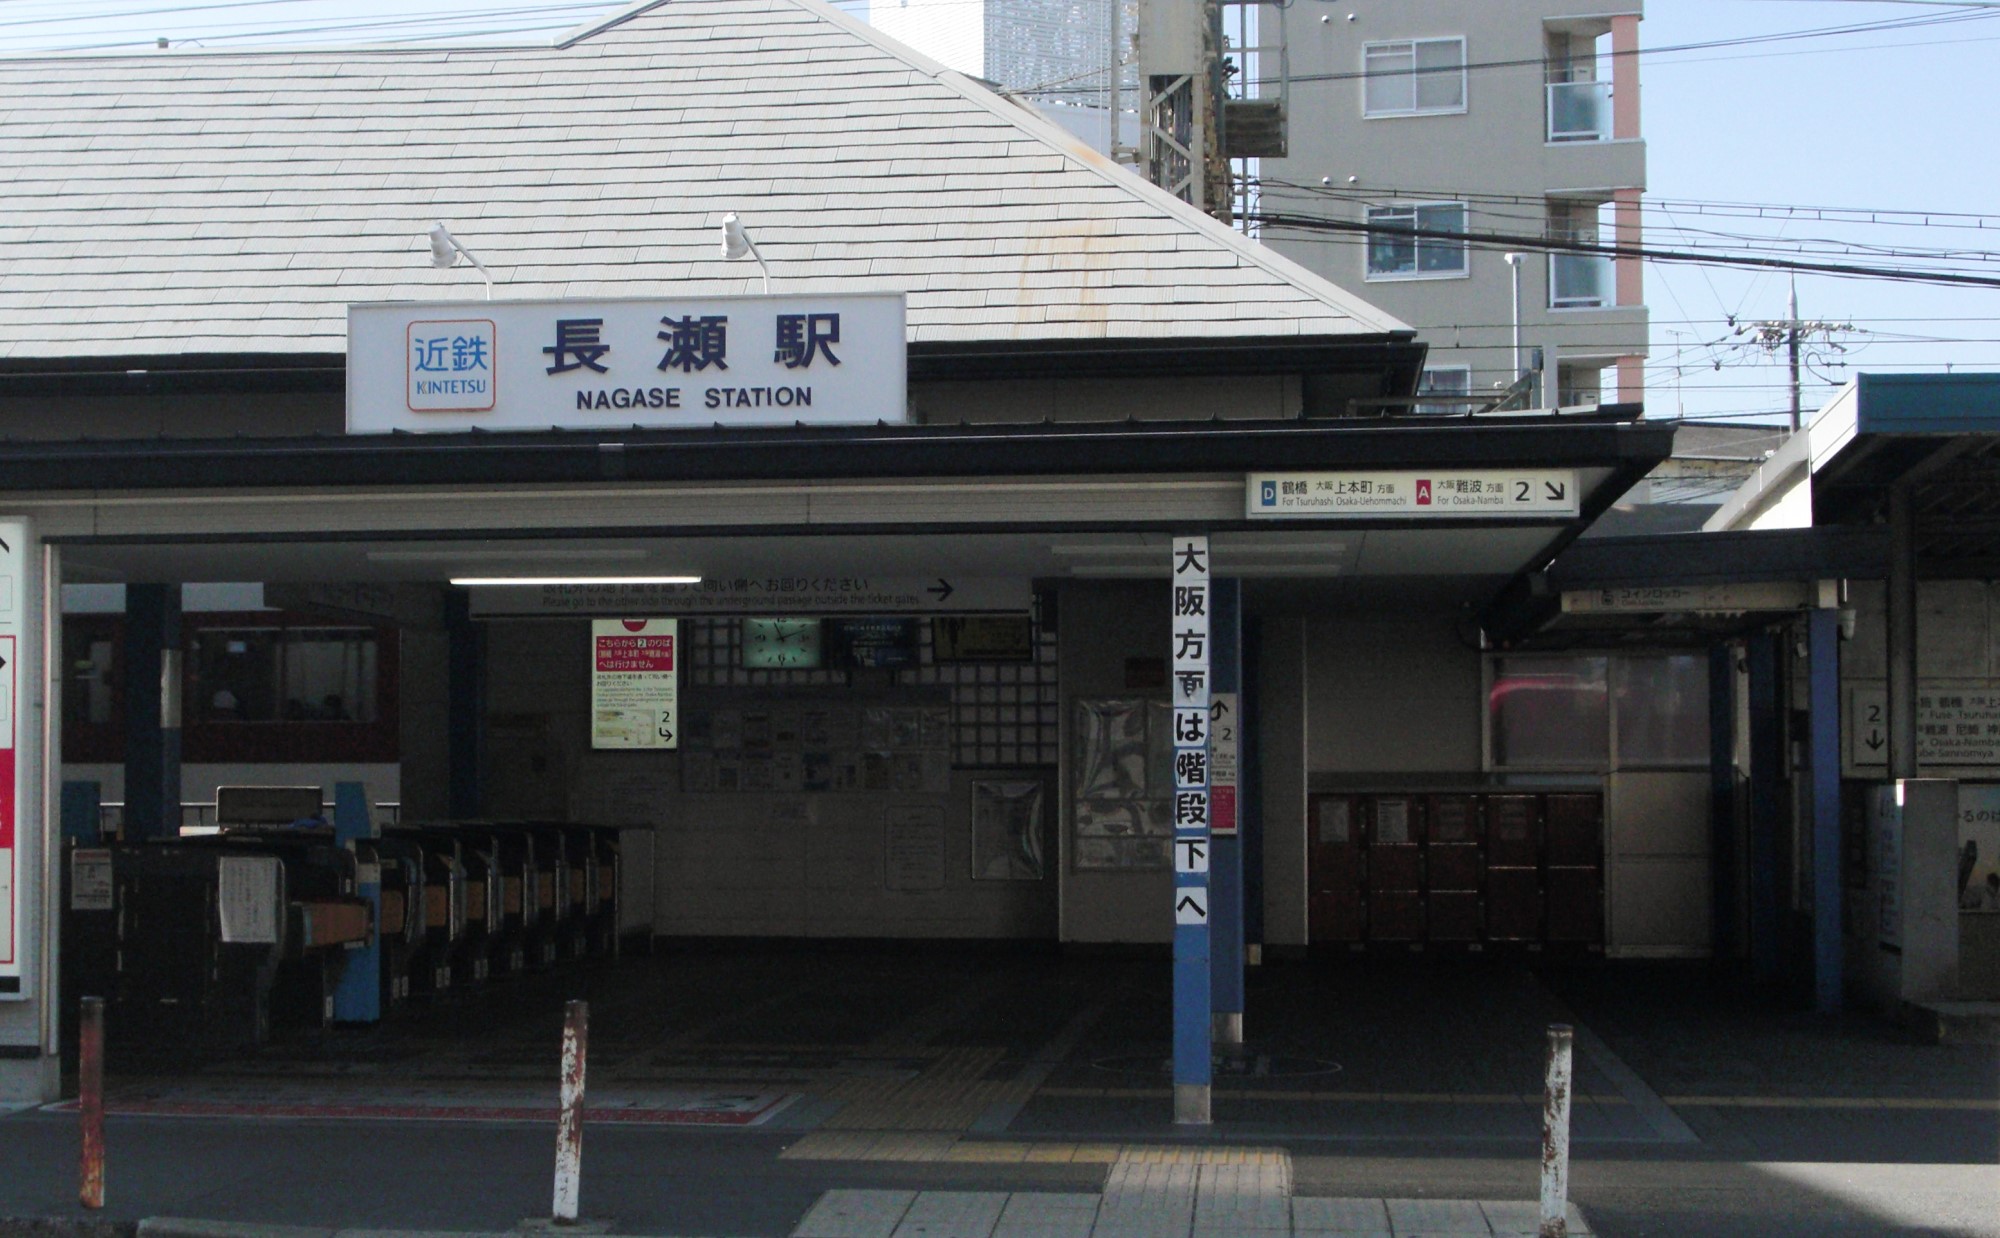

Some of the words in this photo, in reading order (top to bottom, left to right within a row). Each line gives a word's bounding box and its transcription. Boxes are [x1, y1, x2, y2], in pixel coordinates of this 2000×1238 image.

[543, 313, 841, 376] 長瀬駅
[415, 335, 488, 372] 近鉄
[417, 379, 486, 394] KINTETSU
[577, 388, 680, 410] NAGASE
[705, 386, 812, 408] STATION
[1264, 488, 1274, 500] D
[1282, 480, 1308, 495] 鶴橋
[1377, 483, 1395, 494] 方面
[1418, 486, 1429, 498] A
[1486, 483, 1504, 493] 方面
[1515, 481, 1530, 502] 2
[1282, 497, 1294, 505] For
[1437, 496, 1449, 505] For
[1453, 495, 1504, 505] Osaka-Namba
[662, 711, 671, 723] 2
[1868, 705, 1880, 721] 2
[1175, 543, 1206, 918] 大阪方面は階段下へ
[1222, 728, 1231, 740] 2
